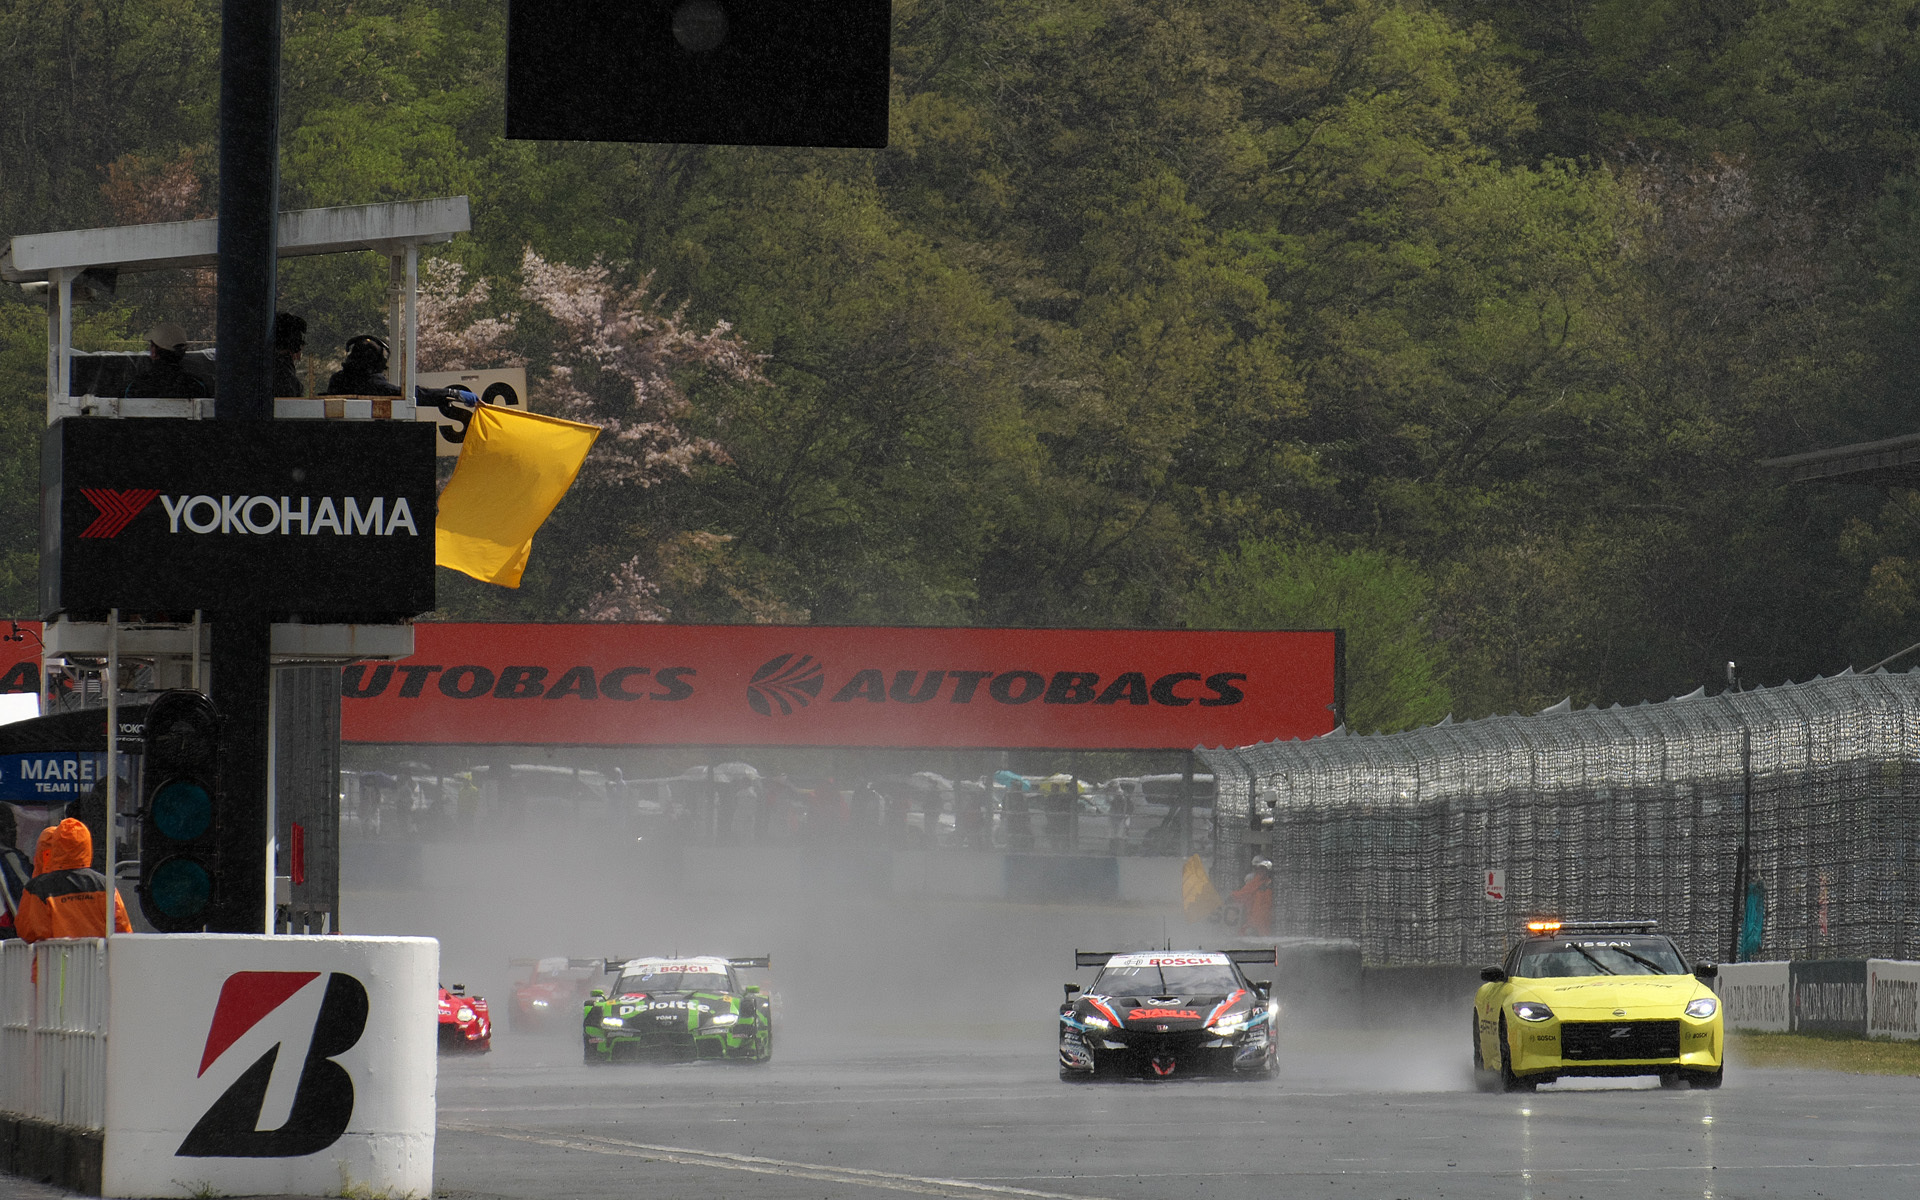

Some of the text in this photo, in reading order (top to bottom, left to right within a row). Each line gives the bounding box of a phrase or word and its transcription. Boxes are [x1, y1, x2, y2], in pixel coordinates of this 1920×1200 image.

[160, 494, 418, 537] YOKOHAMA
[341, 664, 697, 701] UTOBACS
[831, 668, 1248, 708] AUTOBACS
[36, 782, 71, 793] TEAM
[1565, 941, 1632, 949] NISSAN
[1148, 957, 1213, 966] BOSCH
[660, 965, 709, 973] BOSCH
[1128, 1007, 1202, 1020] STANLEY
